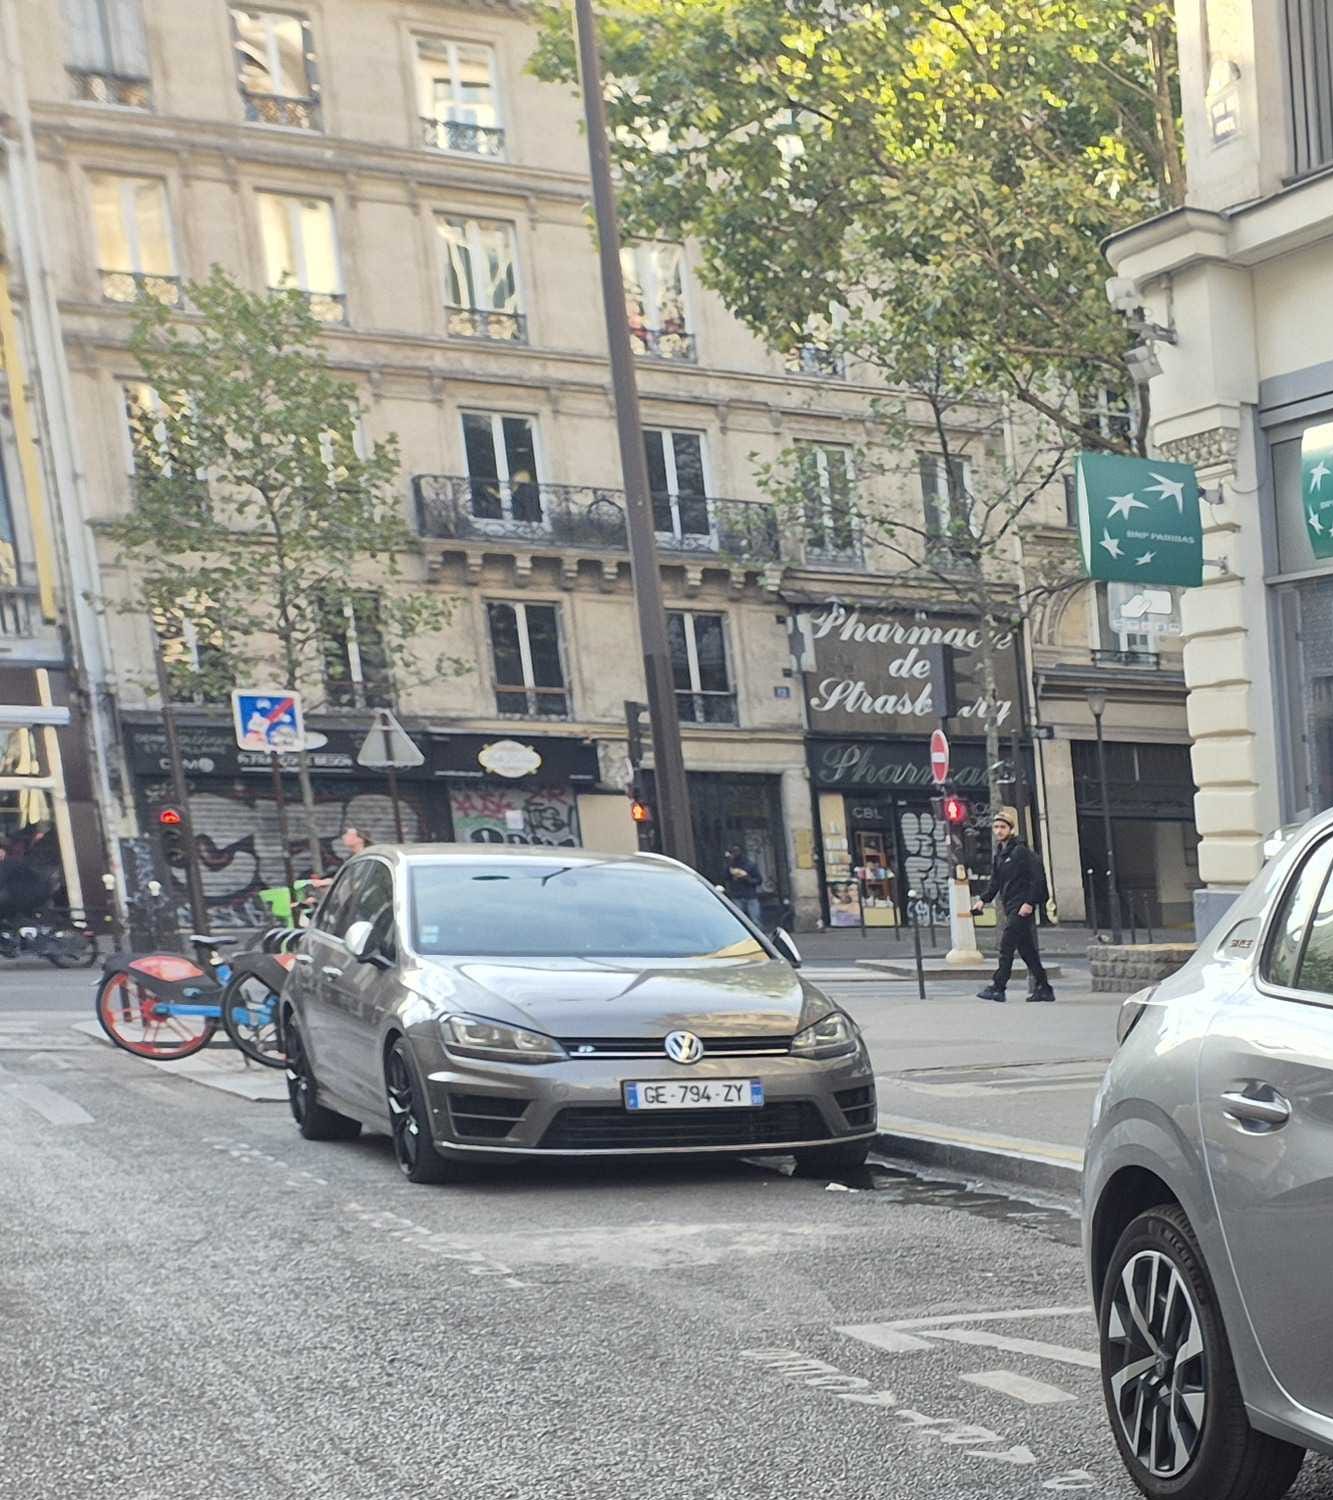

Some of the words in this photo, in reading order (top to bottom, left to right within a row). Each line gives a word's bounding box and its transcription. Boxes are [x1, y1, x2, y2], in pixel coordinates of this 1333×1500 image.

[1126, 529, 1149, 540] BNP
[1150, 531, 1196, 545] PARIBAS
[889, 648, 931, 678] de
[644, 1084, 744, 1104] GE-794-ZY
